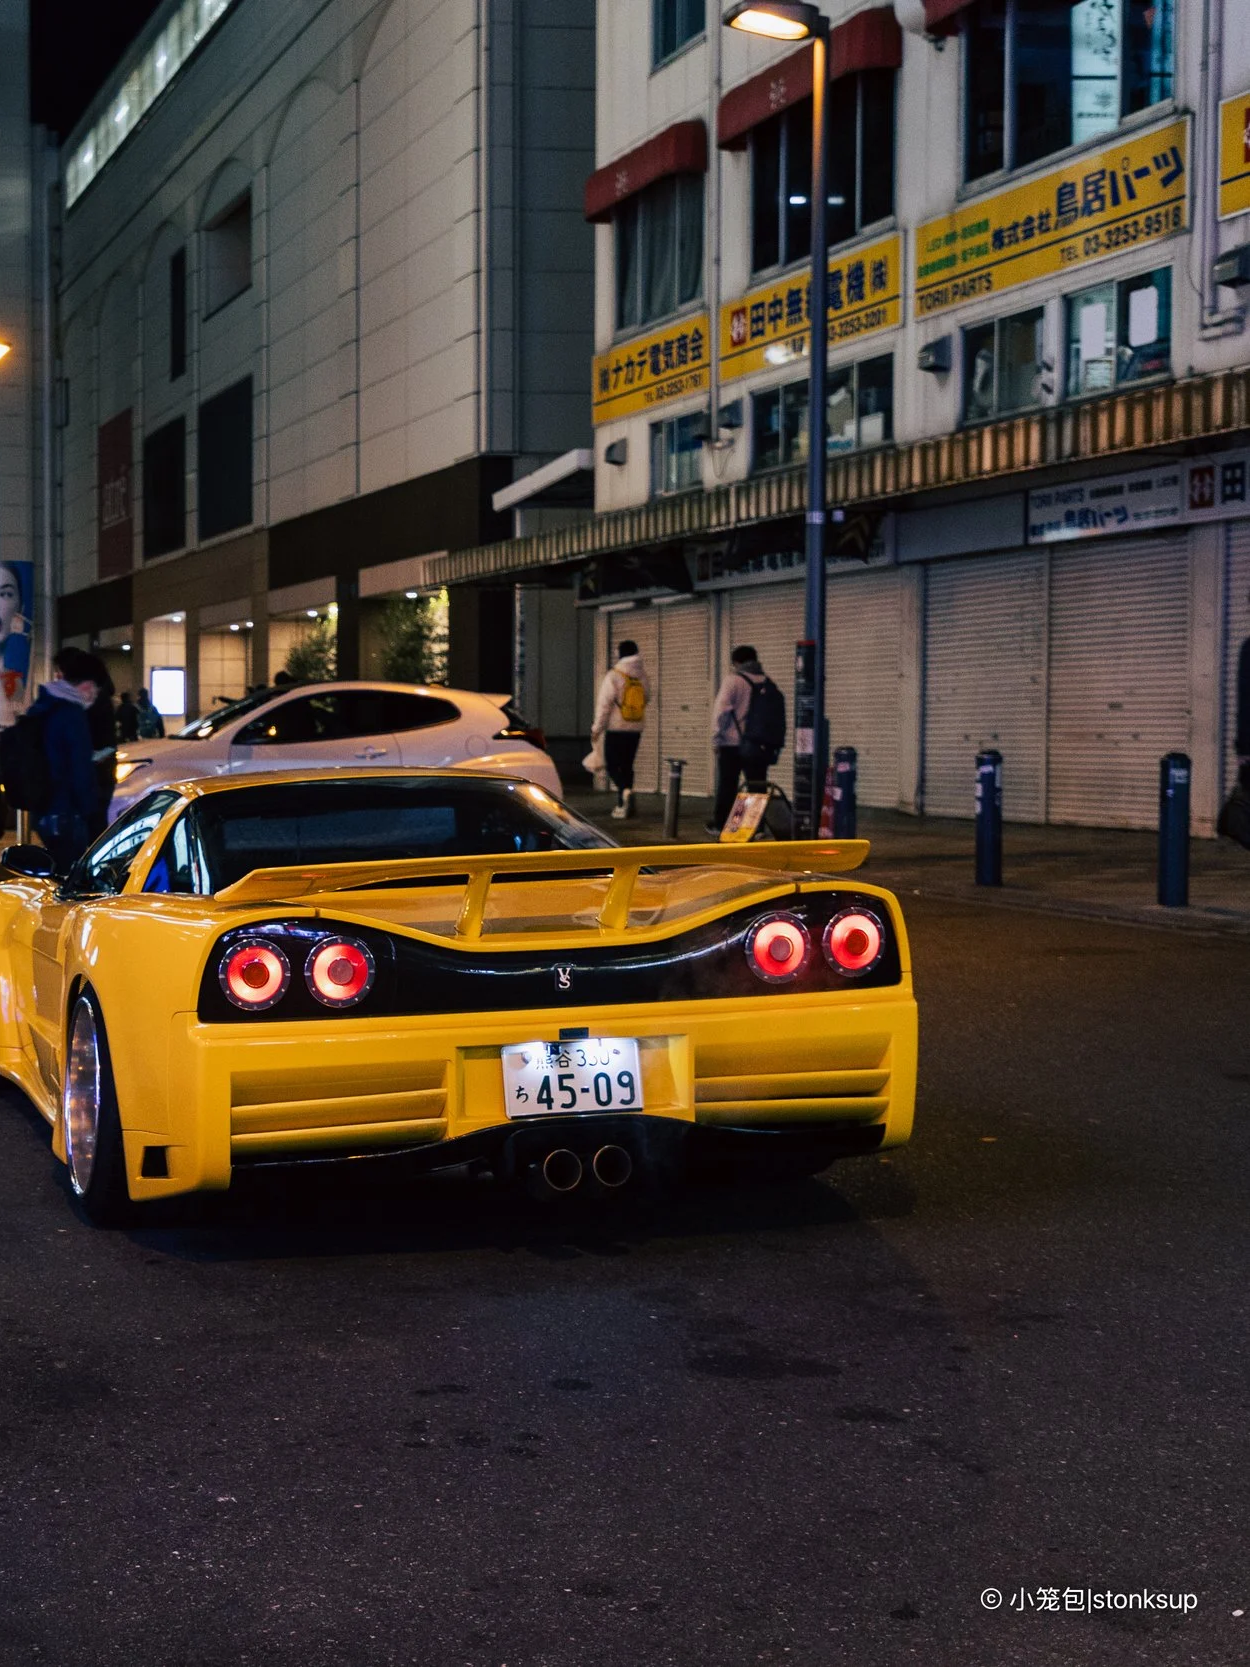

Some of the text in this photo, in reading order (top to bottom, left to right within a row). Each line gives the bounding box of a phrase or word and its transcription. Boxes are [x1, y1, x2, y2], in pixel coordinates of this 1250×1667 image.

[918, 272, 993, 313] TORII PARTS
[1221, 461, 1246, 504] 田
[516, 1070, 636, 1110] ち 45-09
